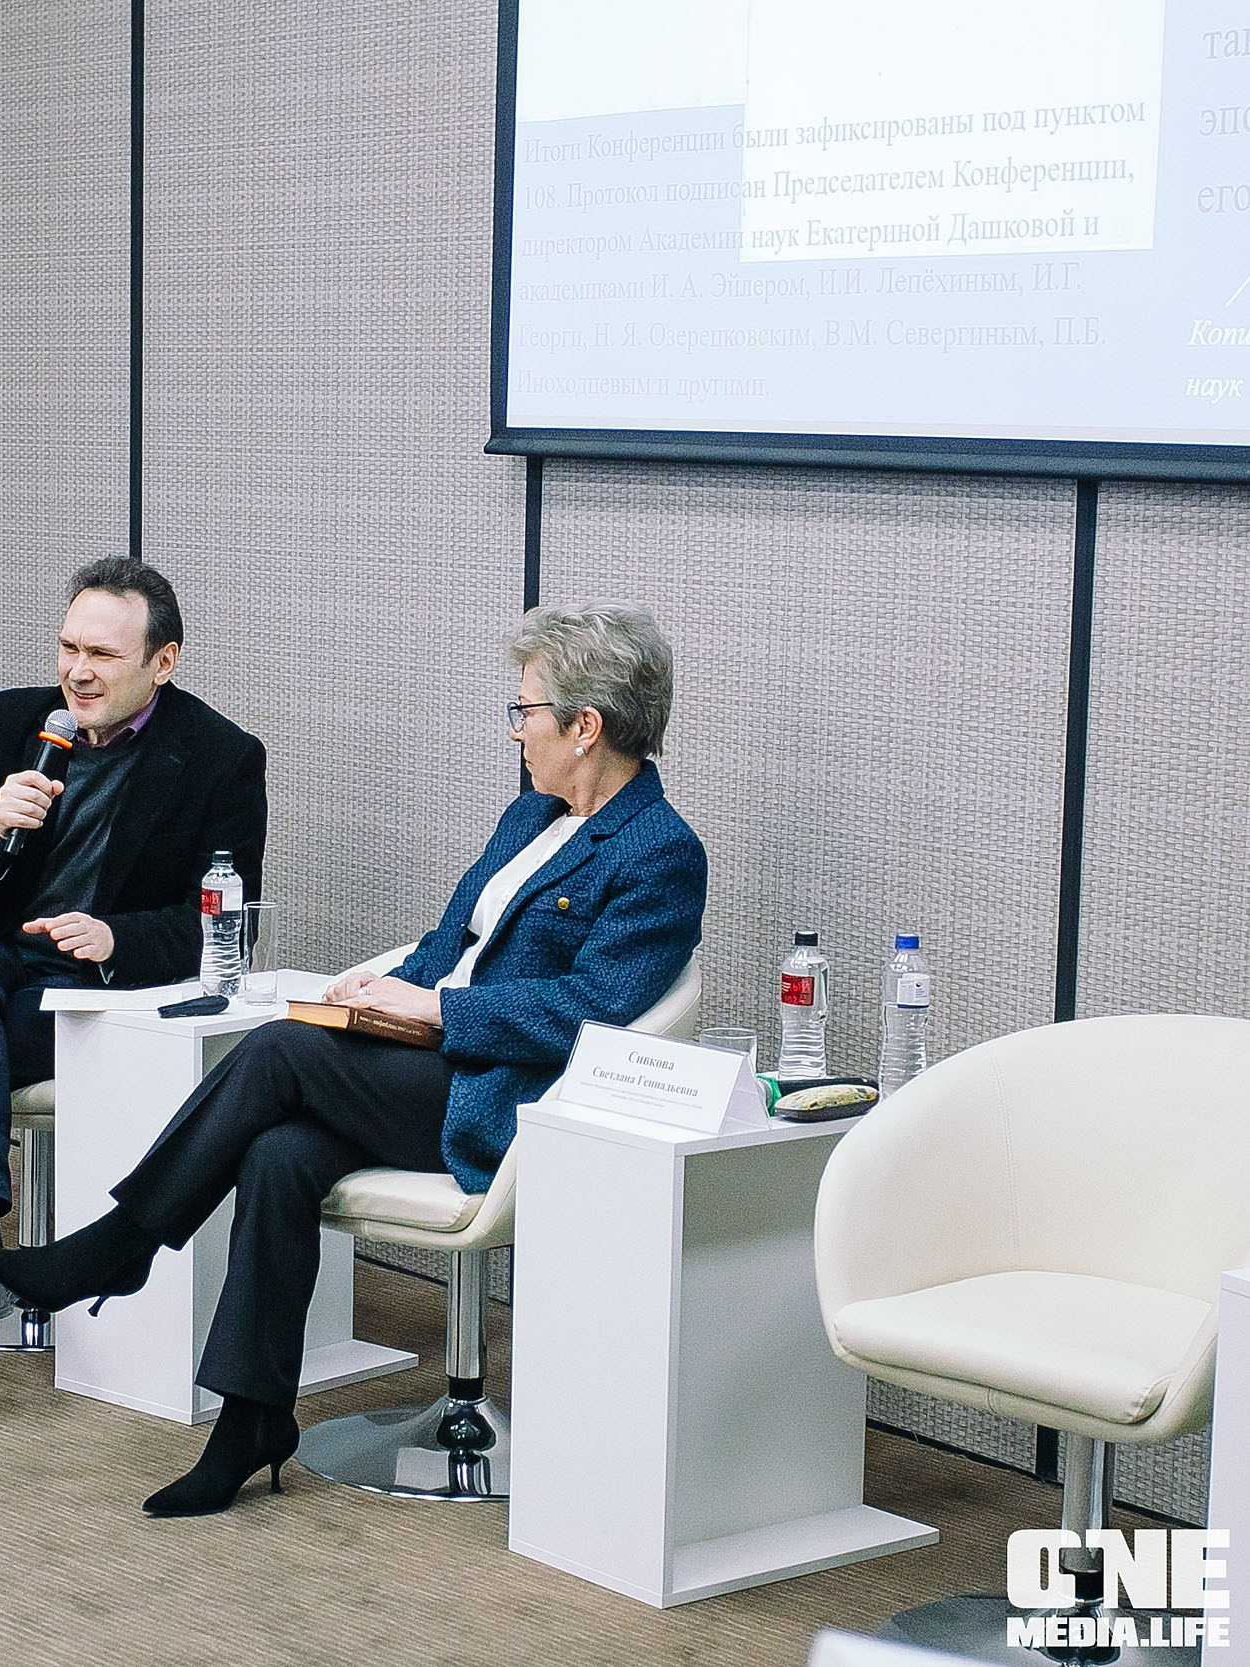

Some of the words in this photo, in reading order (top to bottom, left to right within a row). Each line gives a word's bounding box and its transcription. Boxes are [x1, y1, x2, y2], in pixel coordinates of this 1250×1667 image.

[525, 138, 582, 163] Итоги
[587, 130, 725, 163] Конференции
[733, 121, 788, 149] были
[795, 113, 974, 151] зафиксированы
[982, 108, 1026, 134] под
[1034, 101, 1146, 135] пунктом
[525, 184, 561, 210] 108.
[567, 182, 658, 214] Протокол
[666, 178, 766, 204] подписан
[773, 168, 944, 204] Председателем
[951, 156, 1135, 193] Конференции,
[521, 234, 632, 263] директором
[639, 226, 744, 253] Академии
[751, 226, 800, 255] наук
[806, 214, 940, 252] Екатериной
[947, 208, 1075, 247] Дашковой
[1082, 214, 1100, 237] и
[519, 281, 645, 303] академиками
[651, 273, 673, 299] И.
[680, 273, 703, 299] А.
[711, 272, 810, 304] Эйлером,
[818, 268, 868, 296] И.И.
[876, 266, 1023, 297] Лепёхиным,
[1031, 261, 1082, 292] И.Г.
[518, 323, 588, 355] Георги,
[593, 322, 614, 348] Н.
[622, 322, 641, 348] Я.
[648, 322, 816, 355] Озерецковским,
[823, 319, 877, 347] В.М.
[885, 318, 1044, 354] Севергиным,
[1052, 316, 1107, 346] П.Б.
[516, 369, 651, 398] Иноходцевым
[657, 378, 669, 396] и
[676, 378, 771, 403] другими.
[1184, 377, 1244, 405] наук
[592, 1066, 635, 1086] Светлана
[628, 1050, 675, 1071] Сивкова
